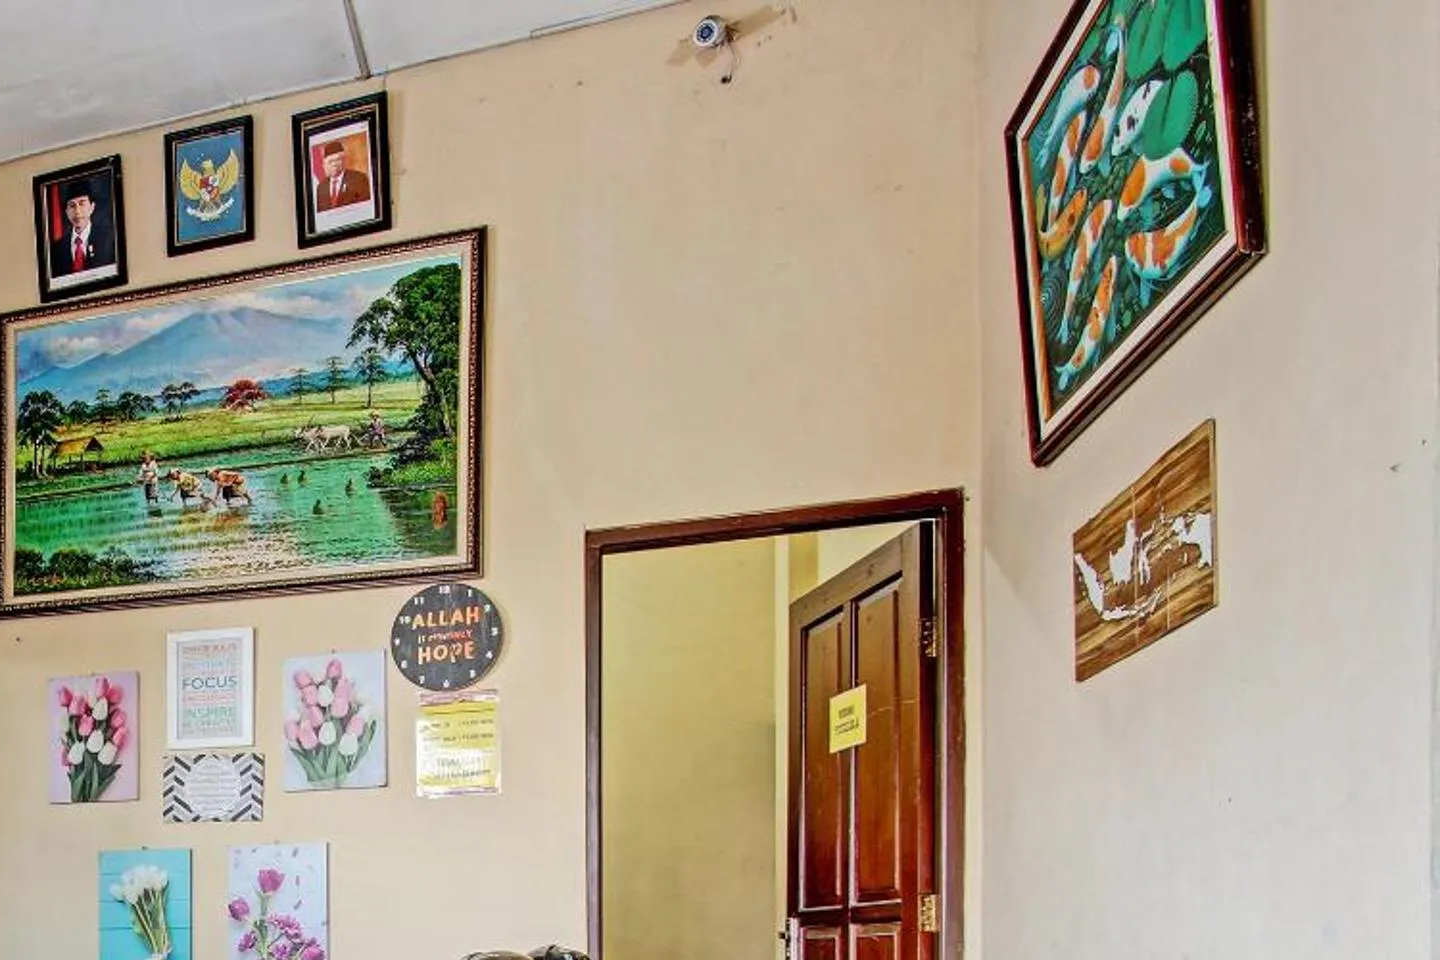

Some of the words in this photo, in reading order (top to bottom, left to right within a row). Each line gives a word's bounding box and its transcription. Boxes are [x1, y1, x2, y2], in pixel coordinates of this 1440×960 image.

[412, 606, 480, 630] ALLAH
[418, 641, 476, 665] HOPE
[182, 675, 237, 690] FOCUS
